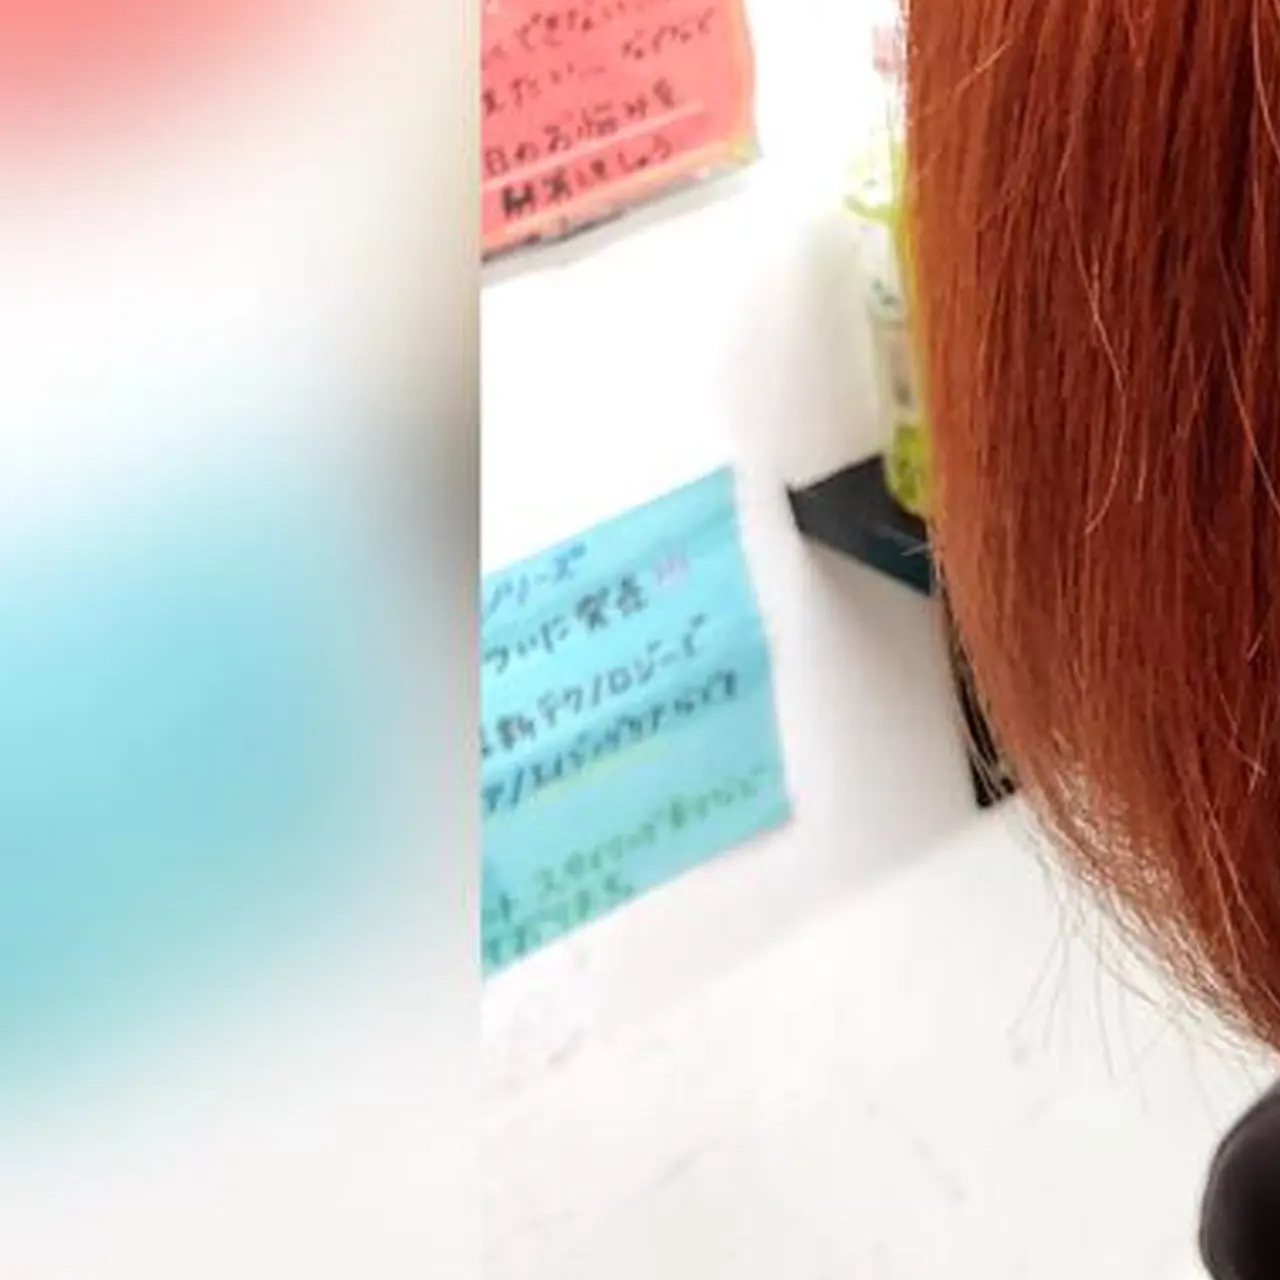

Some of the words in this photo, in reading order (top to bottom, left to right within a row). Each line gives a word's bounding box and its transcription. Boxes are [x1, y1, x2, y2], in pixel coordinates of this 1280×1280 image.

[481, 612, 708, 760] 新テクノロジーで
